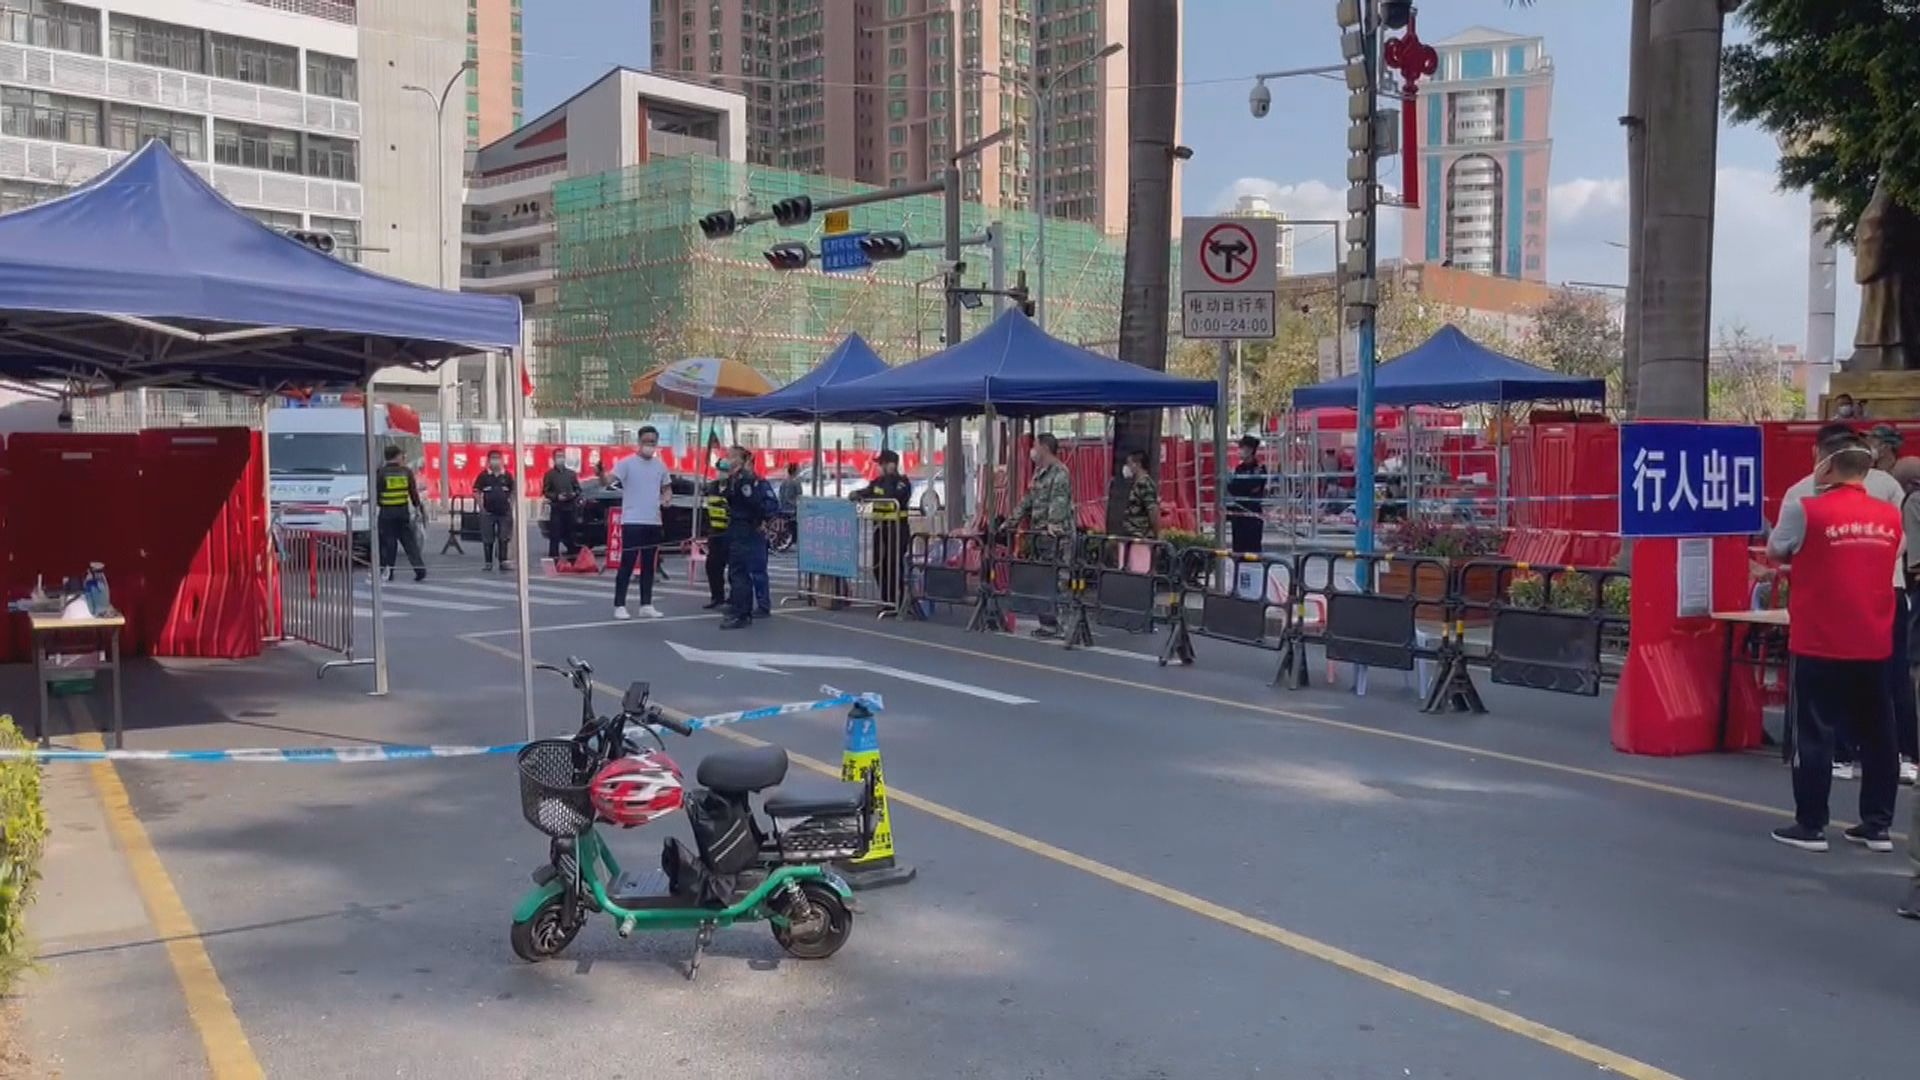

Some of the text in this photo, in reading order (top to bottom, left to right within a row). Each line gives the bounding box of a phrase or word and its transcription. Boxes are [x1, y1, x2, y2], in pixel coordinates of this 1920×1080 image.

[1190, 296, 1267, 314] 电动自行车
[1191, 318, 1268, 332] 0:00-24:00
[1633, 447, 1755, 512] 行人出口
